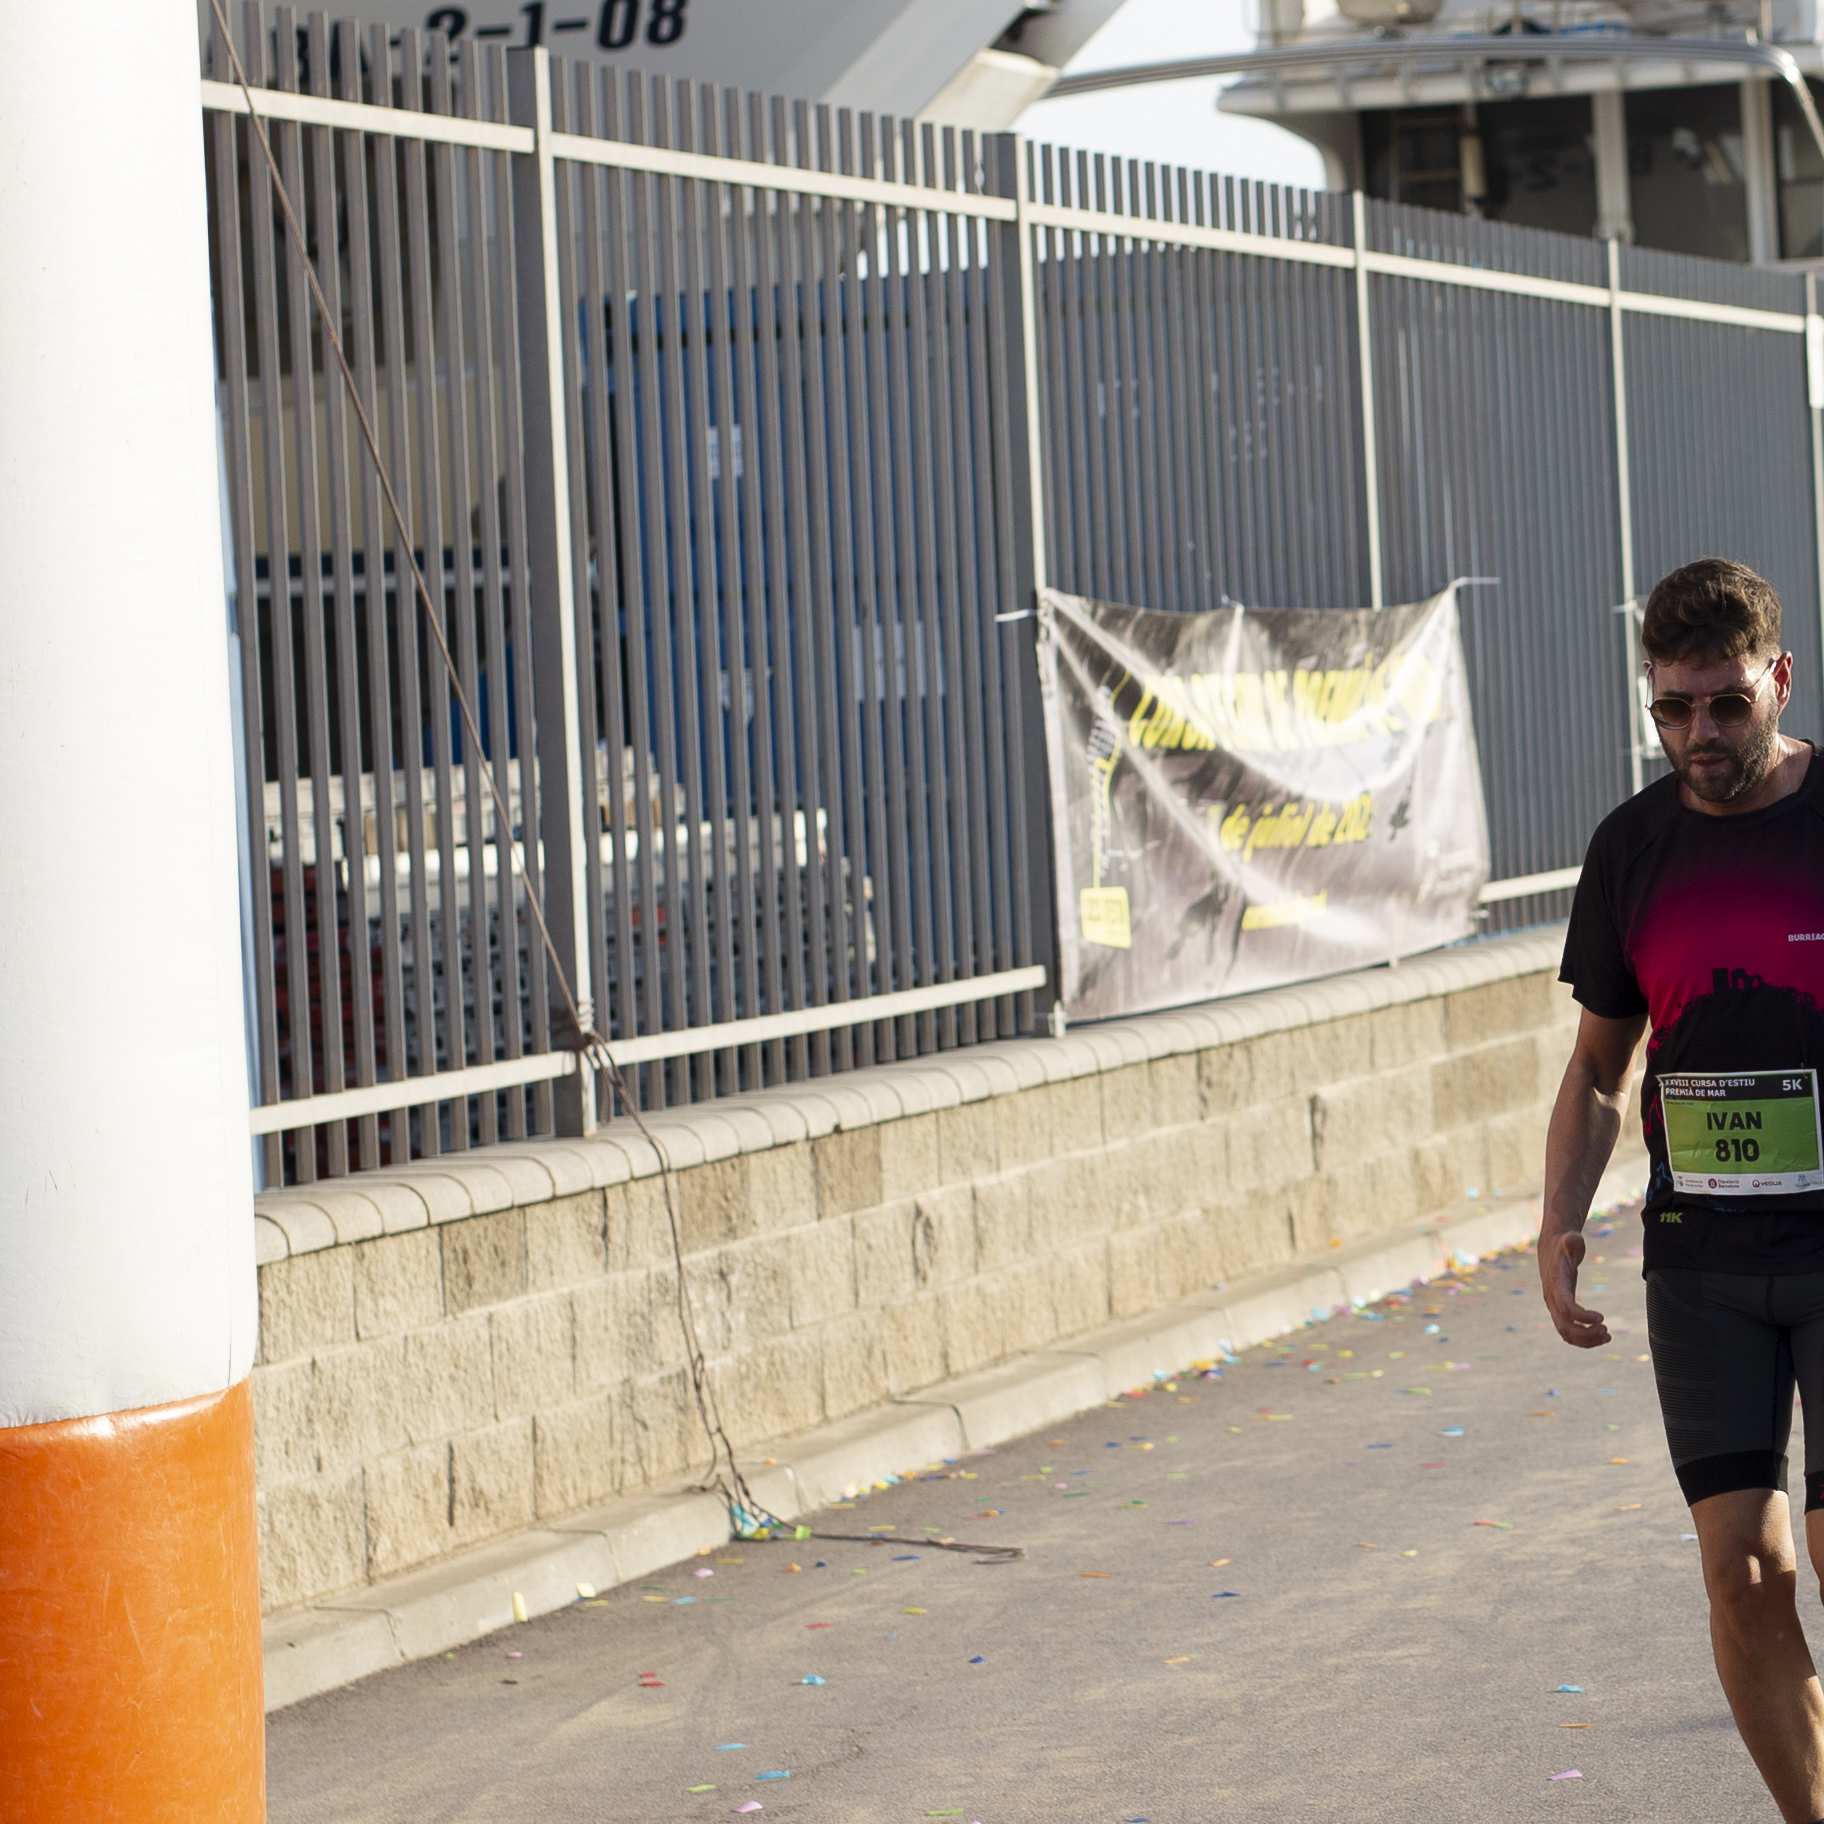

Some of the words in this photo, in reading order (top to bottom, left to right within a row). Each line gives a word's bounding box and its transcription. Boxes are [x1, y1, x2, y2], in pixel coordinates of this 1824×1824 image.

[1665, 1086, 1694, 1096] PREMIÀ
[1690, 1079, 1717, 1087] CURSA
[1782, 1079, 1803, 1091] 5K
[1706, 1111, 1763, 1131] IVAN
[1715, 1138, 1760, 1162] 810
[1659, 1212, 1684, 1223] 11K
